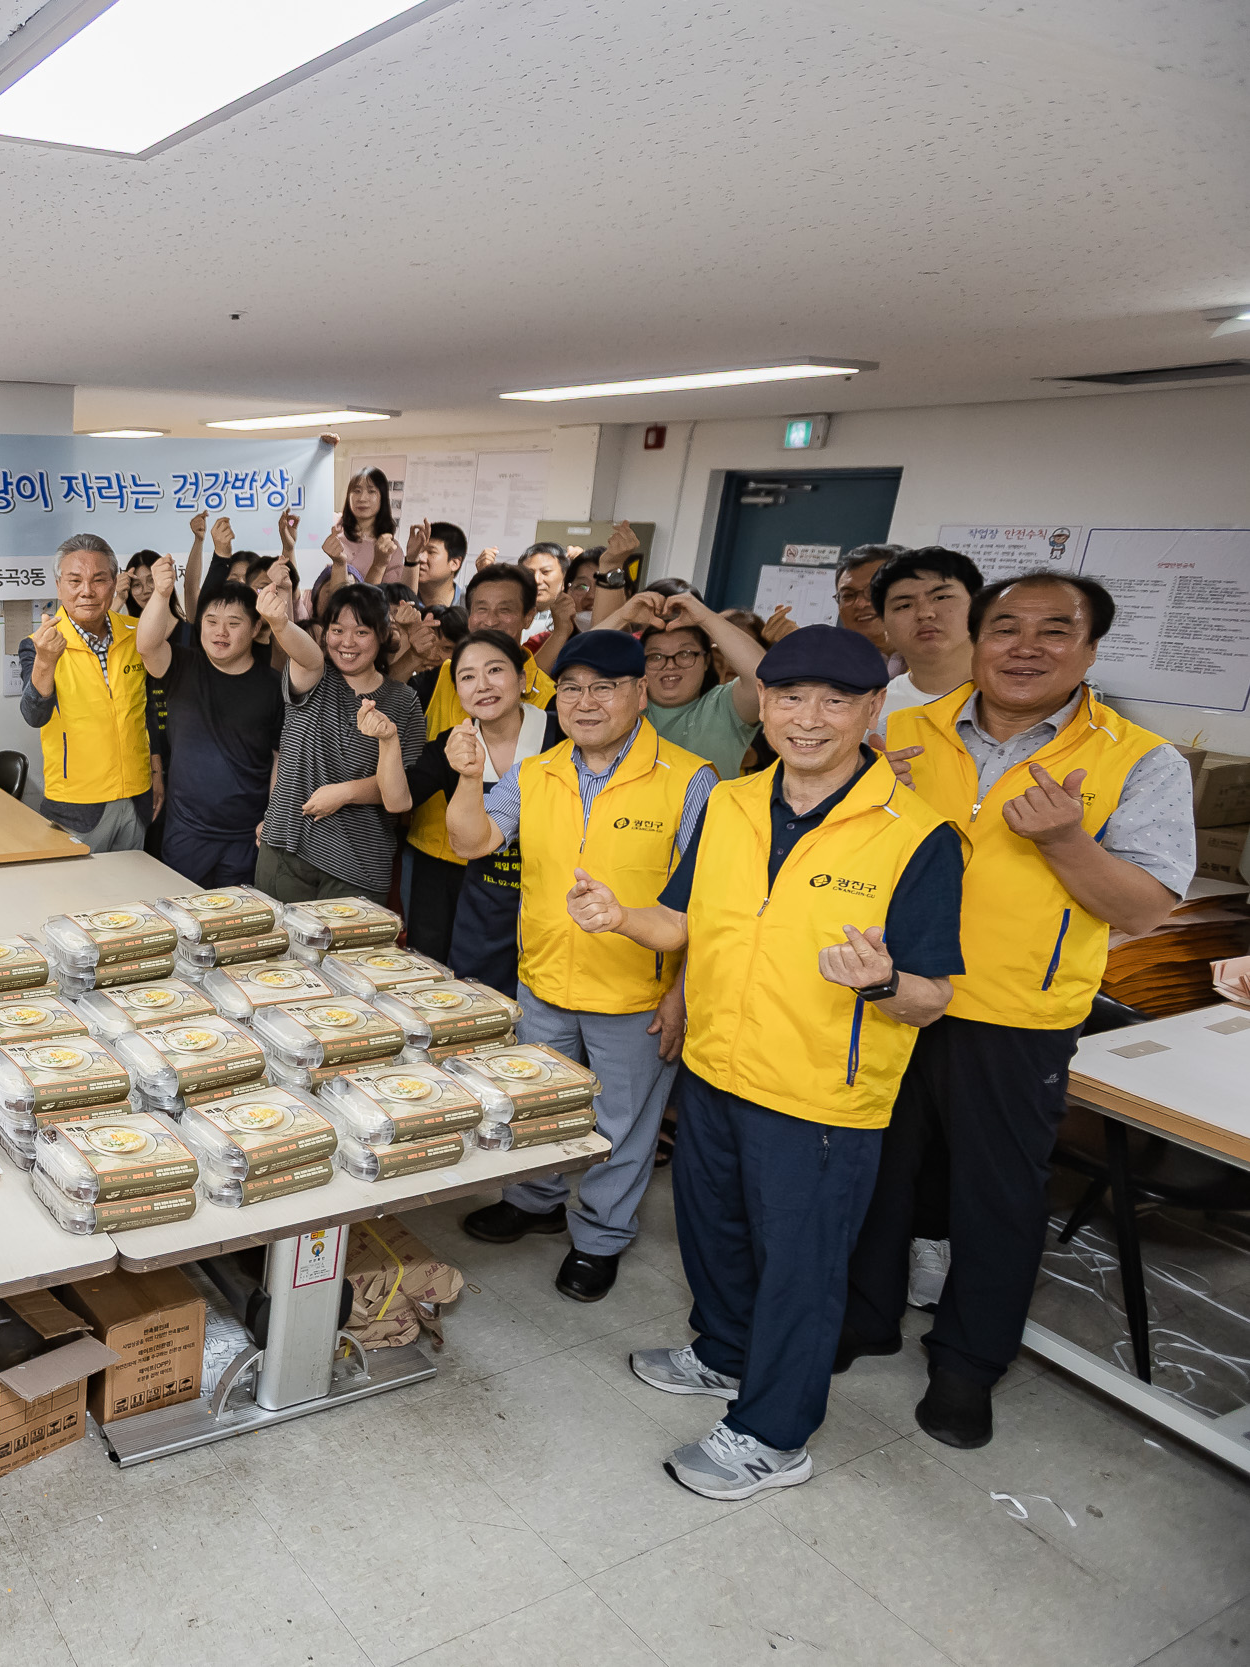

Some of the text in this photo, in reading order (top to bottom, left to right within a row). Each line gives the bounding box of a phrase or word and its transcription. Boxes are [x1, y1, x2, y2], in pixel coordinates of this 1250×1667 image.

[62, 473, 163, 511] 자라는
[172, 468, 305, 511] 건강밥상」
[968, 528, 1049, 540] 작업장 안전수칙
[634, 819, 663, 829] 광진구
[494, 861, 510, 871] 제일
[483, 874, 521, 889] TEL. 02-46
[836, 877, 878, 892] 광진구
[144, 1322, 169, 1335] 판촉물인쇄
[744, 1458, 773, 1481] N
